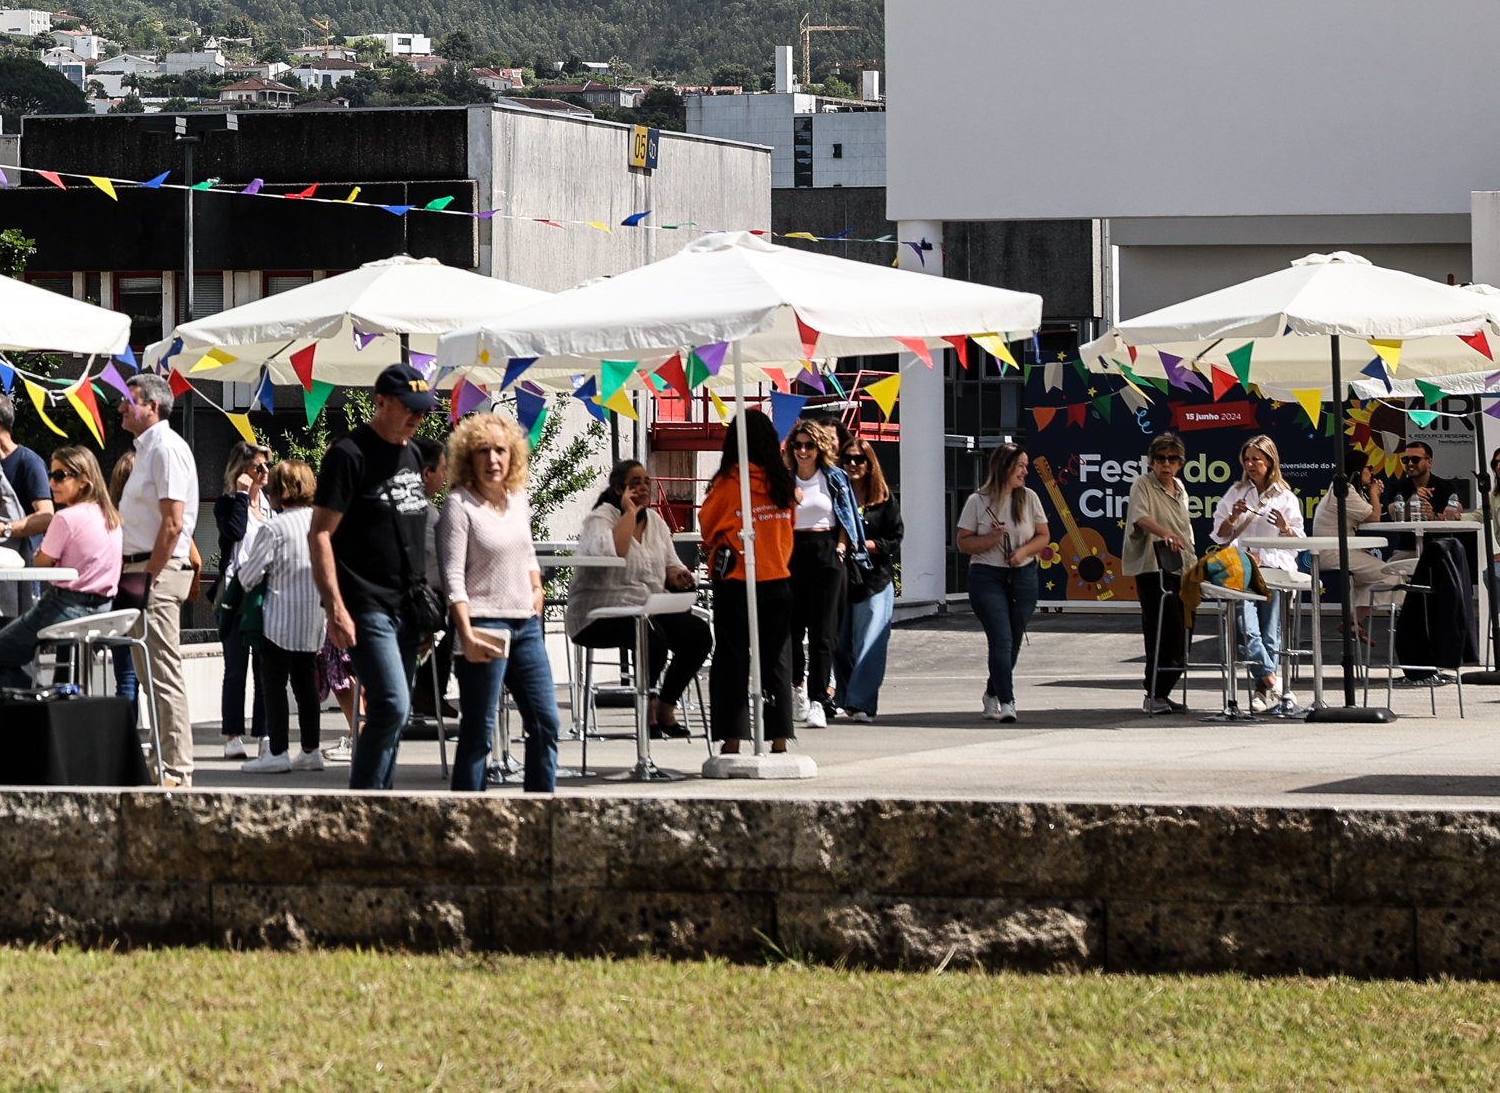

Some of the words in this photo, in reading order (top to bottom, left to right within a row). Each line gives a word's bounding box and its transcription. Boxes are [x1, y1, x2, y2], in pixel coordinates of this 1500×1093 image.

[635, 133, 646, 160] 05
[1195, 413, 1219, 421] junho
[1079, 454, 1151, 483] Fest
[1183, 453, 1231, 483] do
